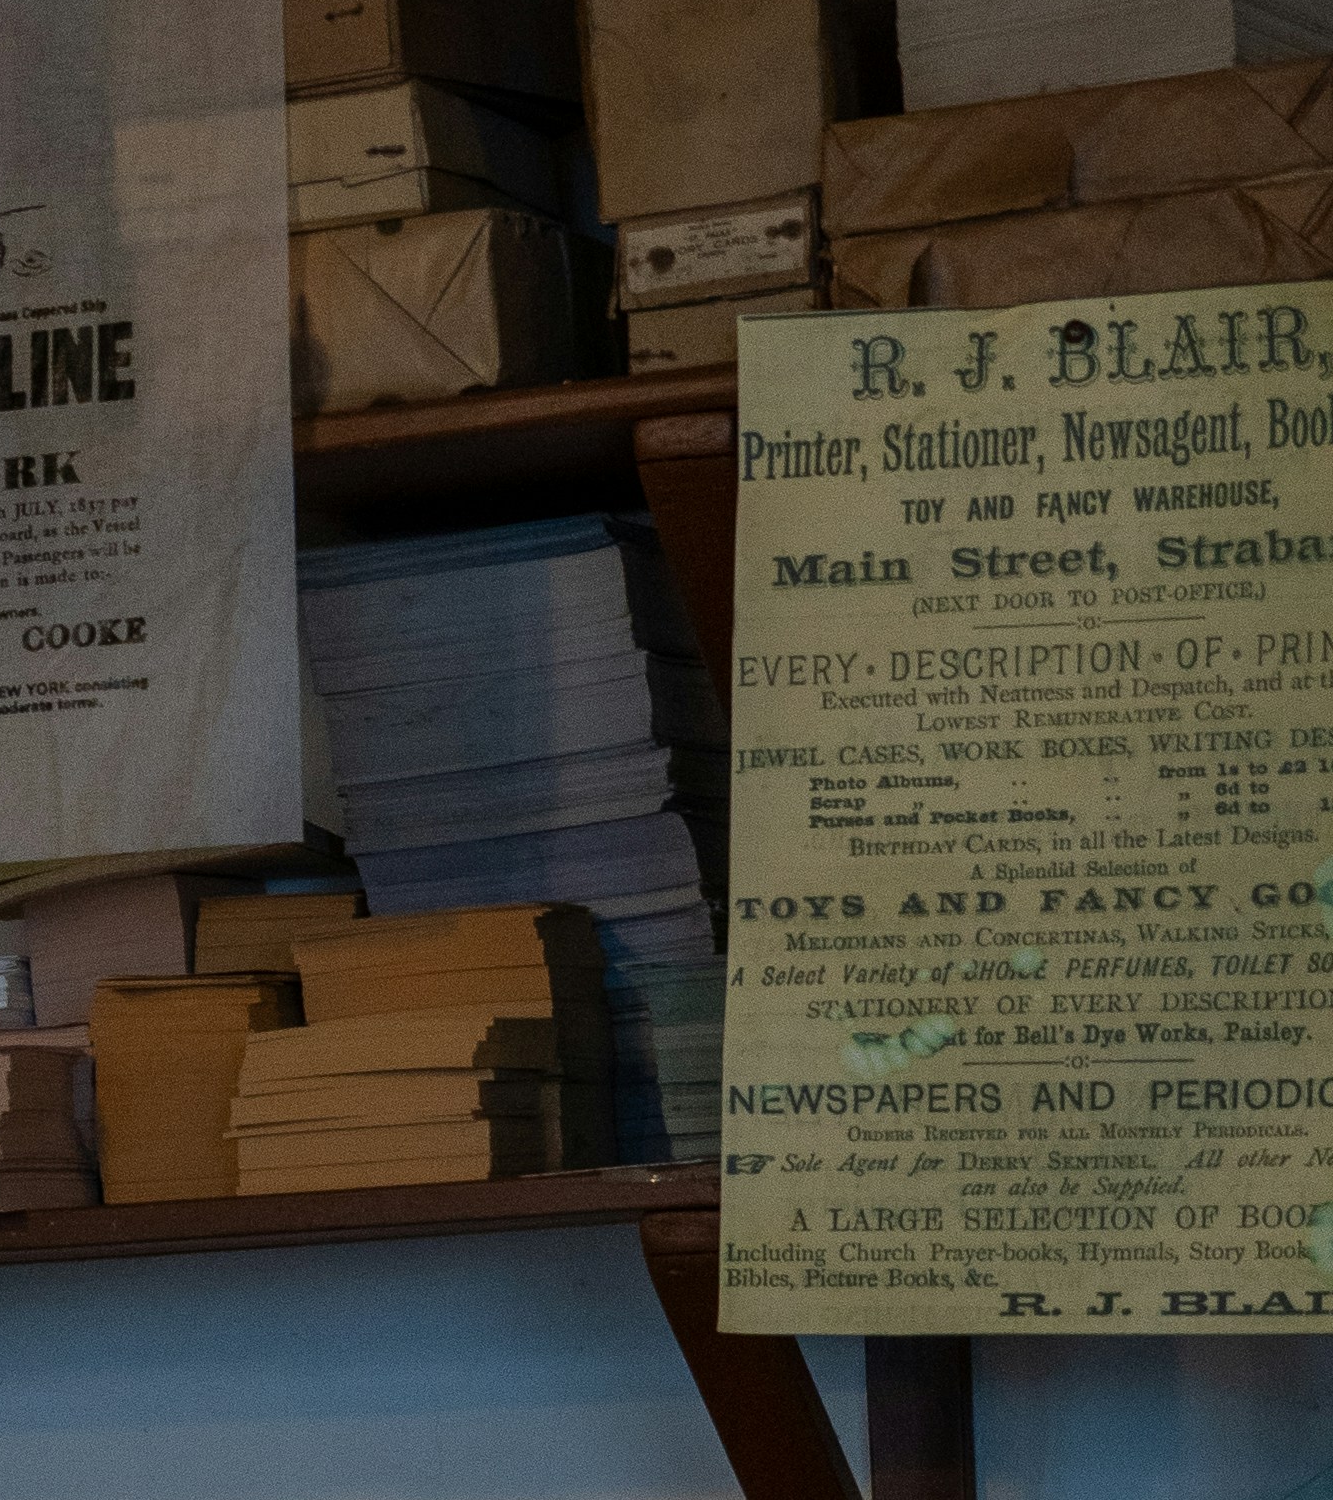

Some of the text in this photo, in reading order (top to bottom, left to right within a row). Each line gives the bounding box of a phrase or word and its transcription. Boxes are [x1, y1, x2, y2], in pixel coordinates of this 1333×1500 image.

[849, 333, 926, 401] R.
[952, 329, 1016, 393] J.
[741, 428, 868, 483] Printer,
[881, 418, 1045, 475] Stationer,
[1060, 400, 1252, 467] Newsagent,
[899, 478, 1280, 525] TOY AND FANCY WAREHOUSE,
[770, 527, 1333, 588] Main Street, Straba
[911, 579, 1266, 619] (NEXT DOOR TO POST-OFFICE,)
[21, 615, 147, 653] COOKE
[738, 650, 859, 687] EVERY
[889, 638, 1141, 682] DESCRIPTION
[1175, 634, 1223, 671] OF
[735, 893, 866, 921] TOYS
[897, 889, 1007, 917] AND
[1039, 883, 1219, 914] FANCY
[727, 1081, 1002, 1116] NEWSPAPERS
[1030, 1079, 1116, 1113] AND
[788, 1206, 811, 1232] A
[827, 1205, 943, 1232] LARGE
[960, 1204, 1157, 1232] SELECTION
[1174, 1203, 1220, 1230] OF
[998, 1290, 1063, 1317] R.
[1085, 1290, 1133, 1317] J.
